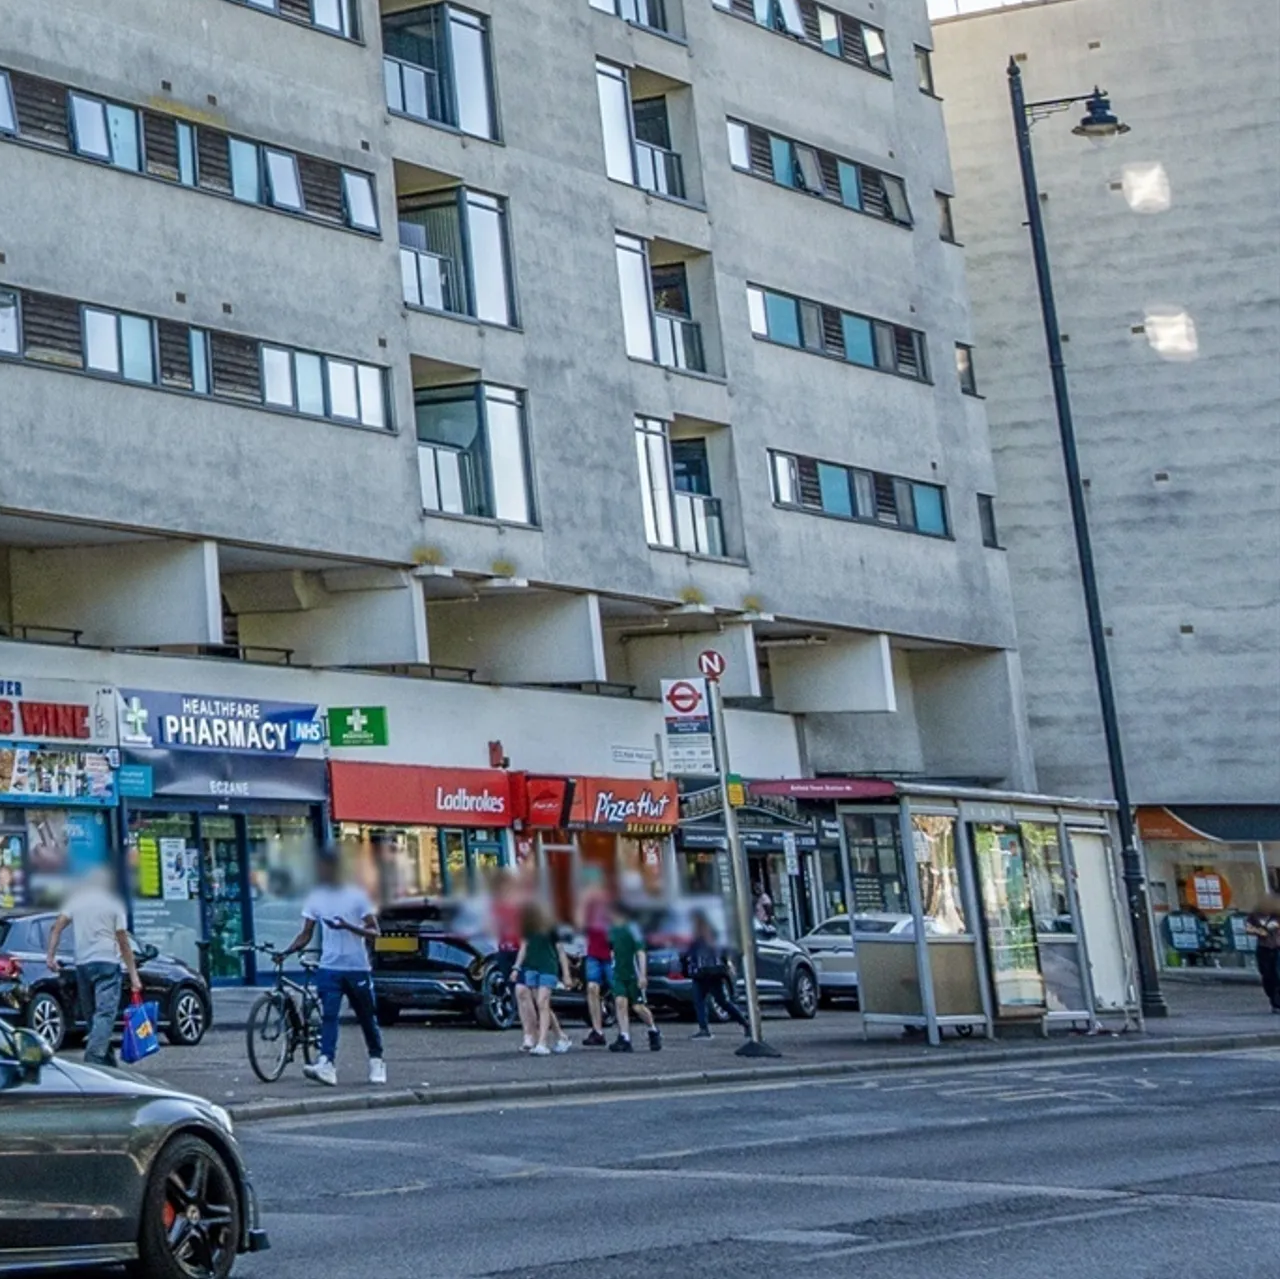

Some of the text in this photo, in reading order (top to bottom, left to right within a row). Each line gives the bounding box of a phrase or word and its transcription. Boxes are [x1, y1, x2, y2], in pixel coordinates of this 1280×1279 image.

[701, 654, 720, 674] N
[18, 701, 90, 739] WINE
[183, 697, 260, 719] HEALTHFARE
[165, 715, 288, 750] PHARMACY
[296, 721, 321, 741] NHS
[209, 780, 250, 796] ECZANE
[437, 786, 505, 813] Ladbrokes
[594, 791, 635, 823] Pizza
[637, 791, 670, 817] Hut
